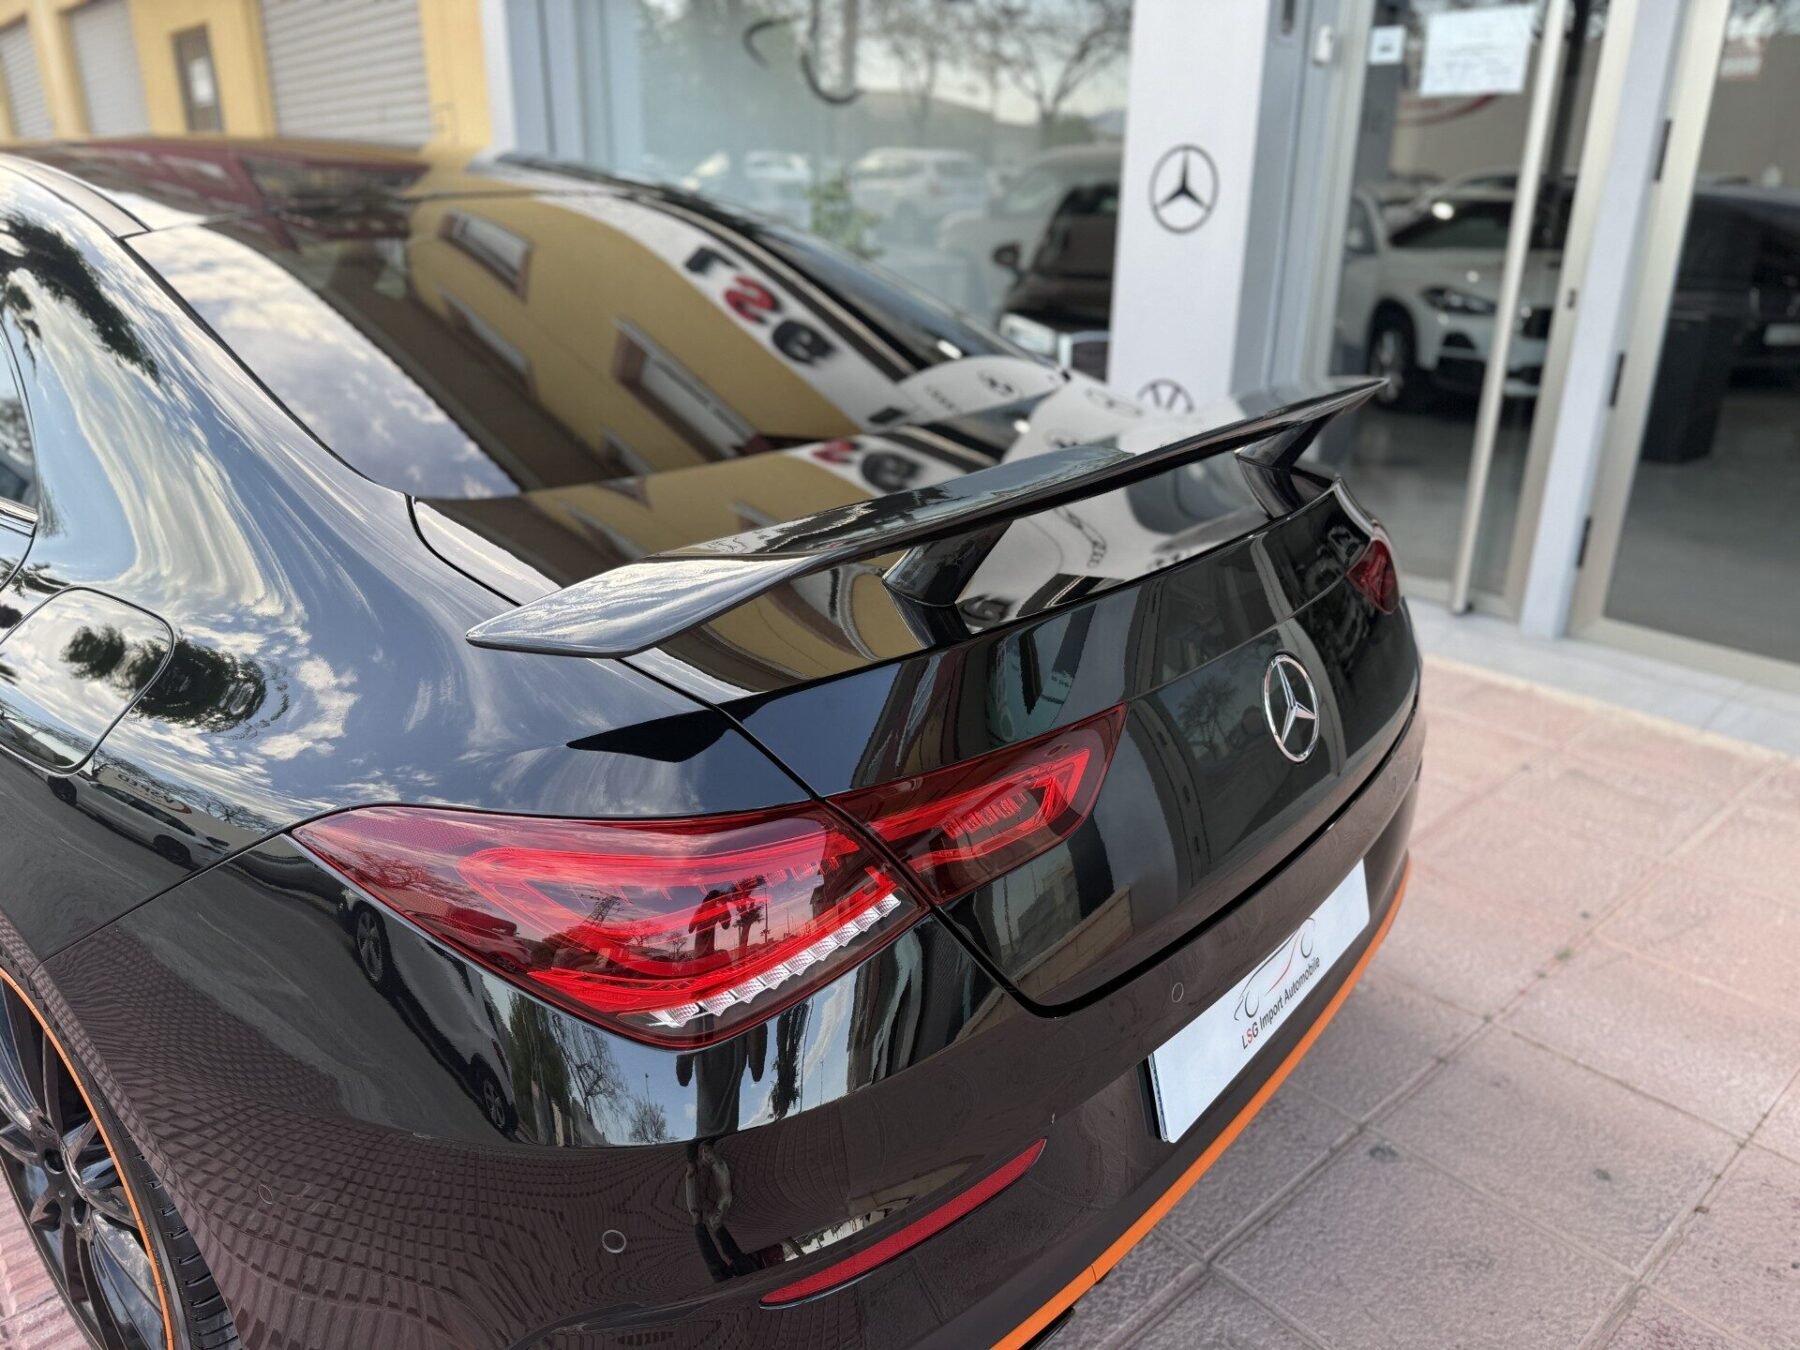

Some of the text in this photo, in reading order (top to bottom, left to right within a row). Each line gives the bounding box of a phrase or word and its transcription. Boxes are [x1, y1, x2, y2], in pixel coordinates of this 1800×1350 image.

[1241, 956, 1320, 1049] LSG Import Automobile
